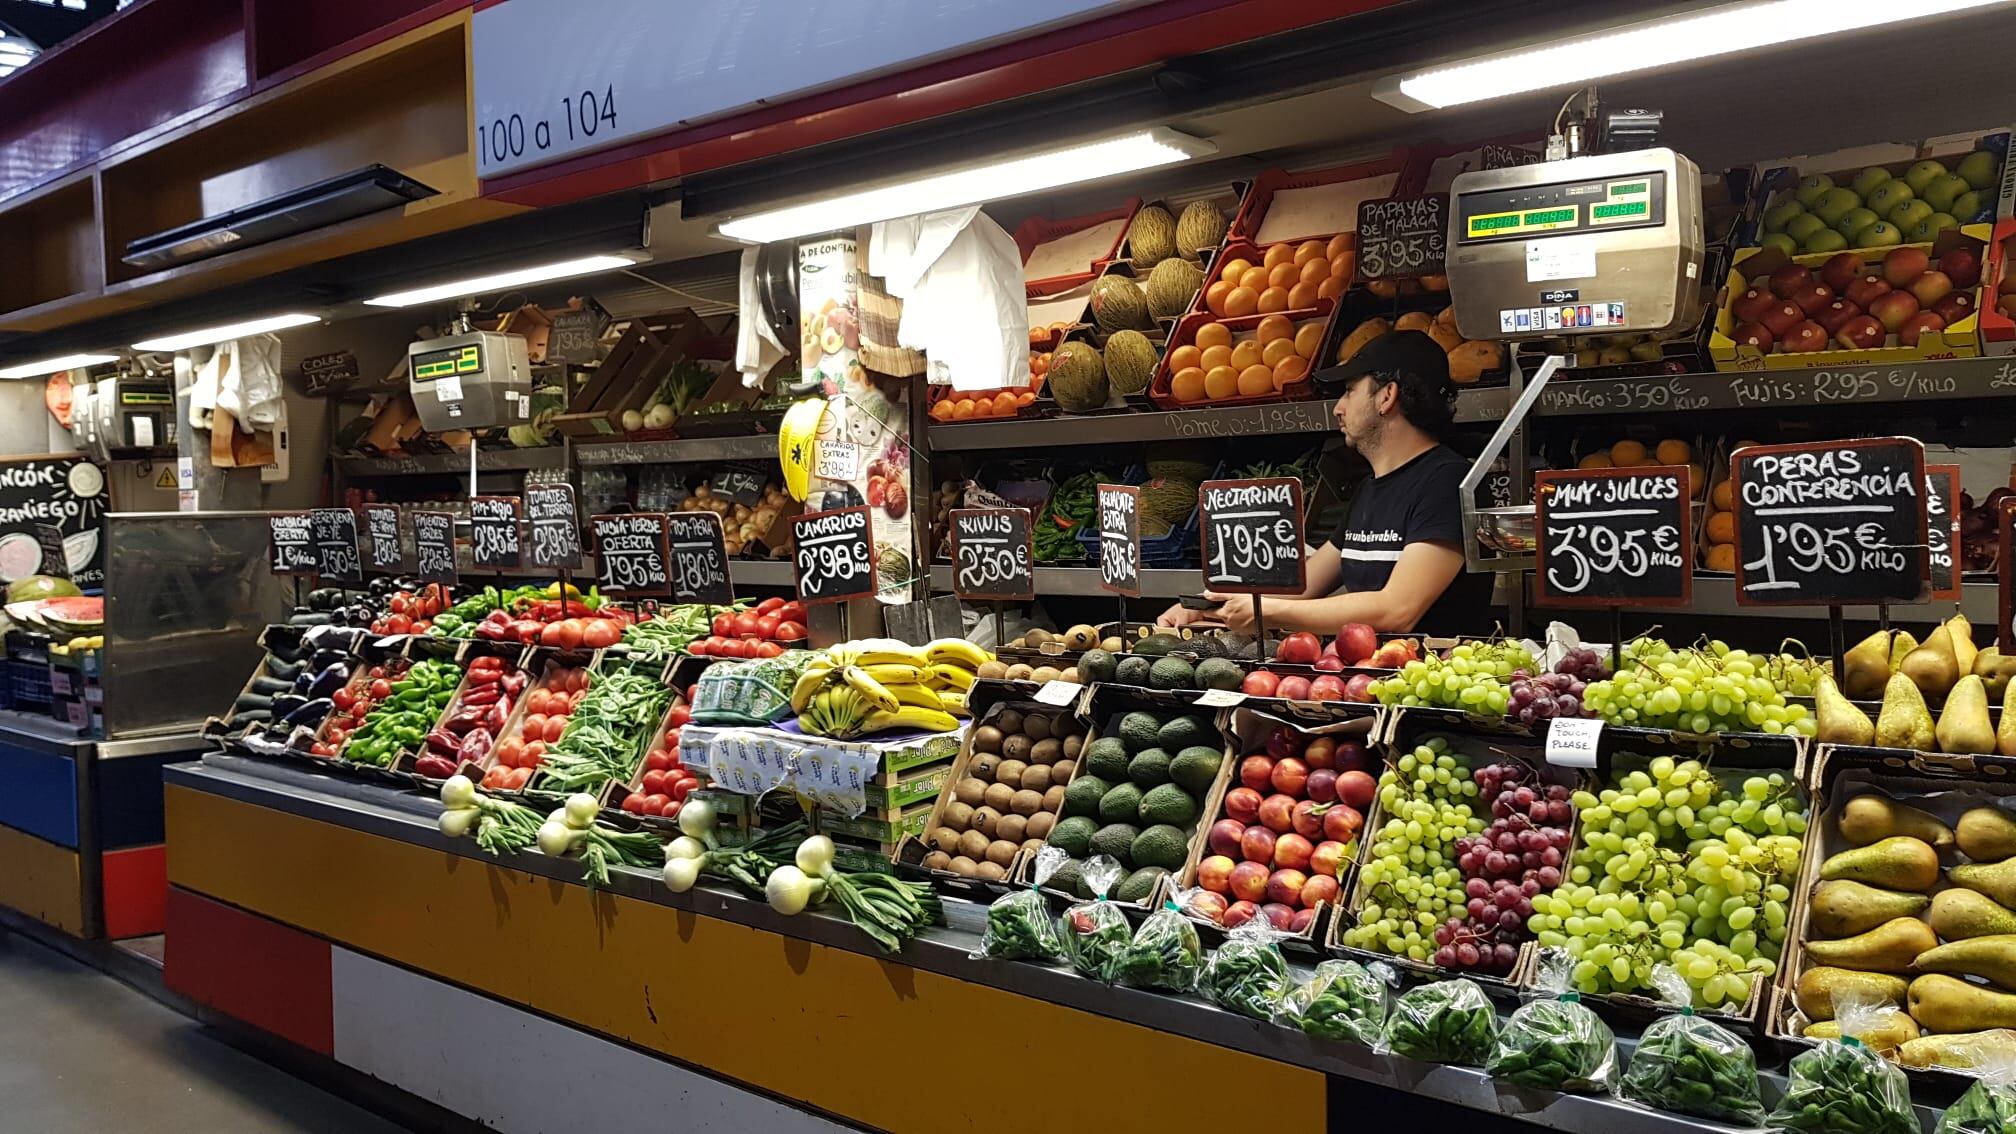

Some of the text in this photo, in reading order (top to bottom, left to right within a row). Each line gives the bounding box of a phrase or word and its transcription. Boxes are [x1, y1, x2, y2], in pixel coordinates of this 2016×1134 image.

[479, 83, 616, 166] 100 a 104
[1364, 198, 1439, 221] PAPAYAS
[1546, 292, 1573, 300] DINA
[1753, 450, 1861, 482] PERAS
[528, 489, 567, 505] TOMATES
[1743, 466, 1916, 507] CONFERENCIA
[1204, 484, 1293, 511] NECTARINA
[795, 512, 865, 538] CANARIOS
[959, 512, 1013, 535] KIWIS
[1103, 509, 1127, 533] EXTRA
[273, 529, 310, 541] OFERTA
[603, 535, 655, 550] OFERTA
[1276, 545, 1299, 560] KILO
[1650, 551, 1683, 568] KILO
[1861, 552, 1906, 571] KILO
[649, 570, 666, 583] KILO
